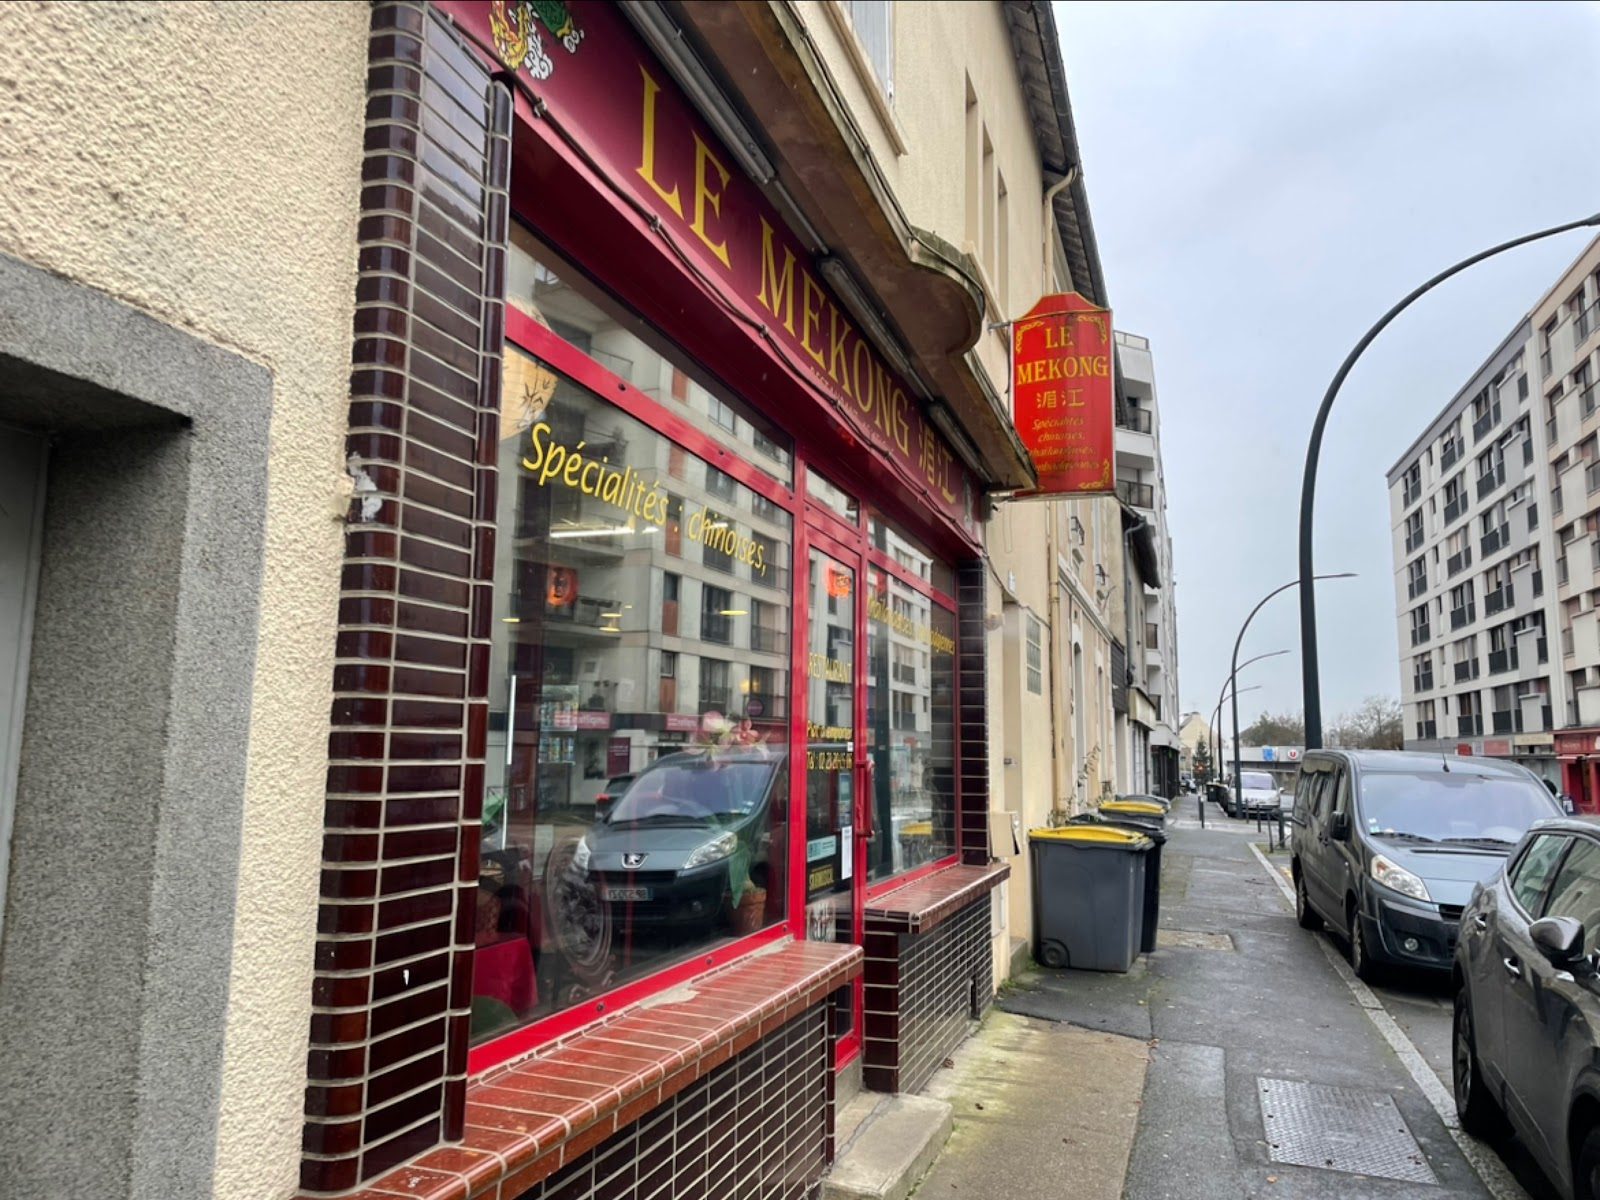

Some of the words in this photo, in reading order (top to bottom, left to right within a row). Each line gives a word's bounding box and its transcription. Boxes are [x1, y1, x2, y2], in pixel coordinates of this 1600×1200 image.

[637, 63, 732, 270] LE
[756, 214, 911, 458] MEKONG
[1045, 327, 1074, 349] LE
[1016, 356, 1109, 385] MEKONG
[522, 422, 669, 526] Spécialités
[688, 505, 768, 577] chinoises,
[807, 652, 852, 684] RESTAURANT
